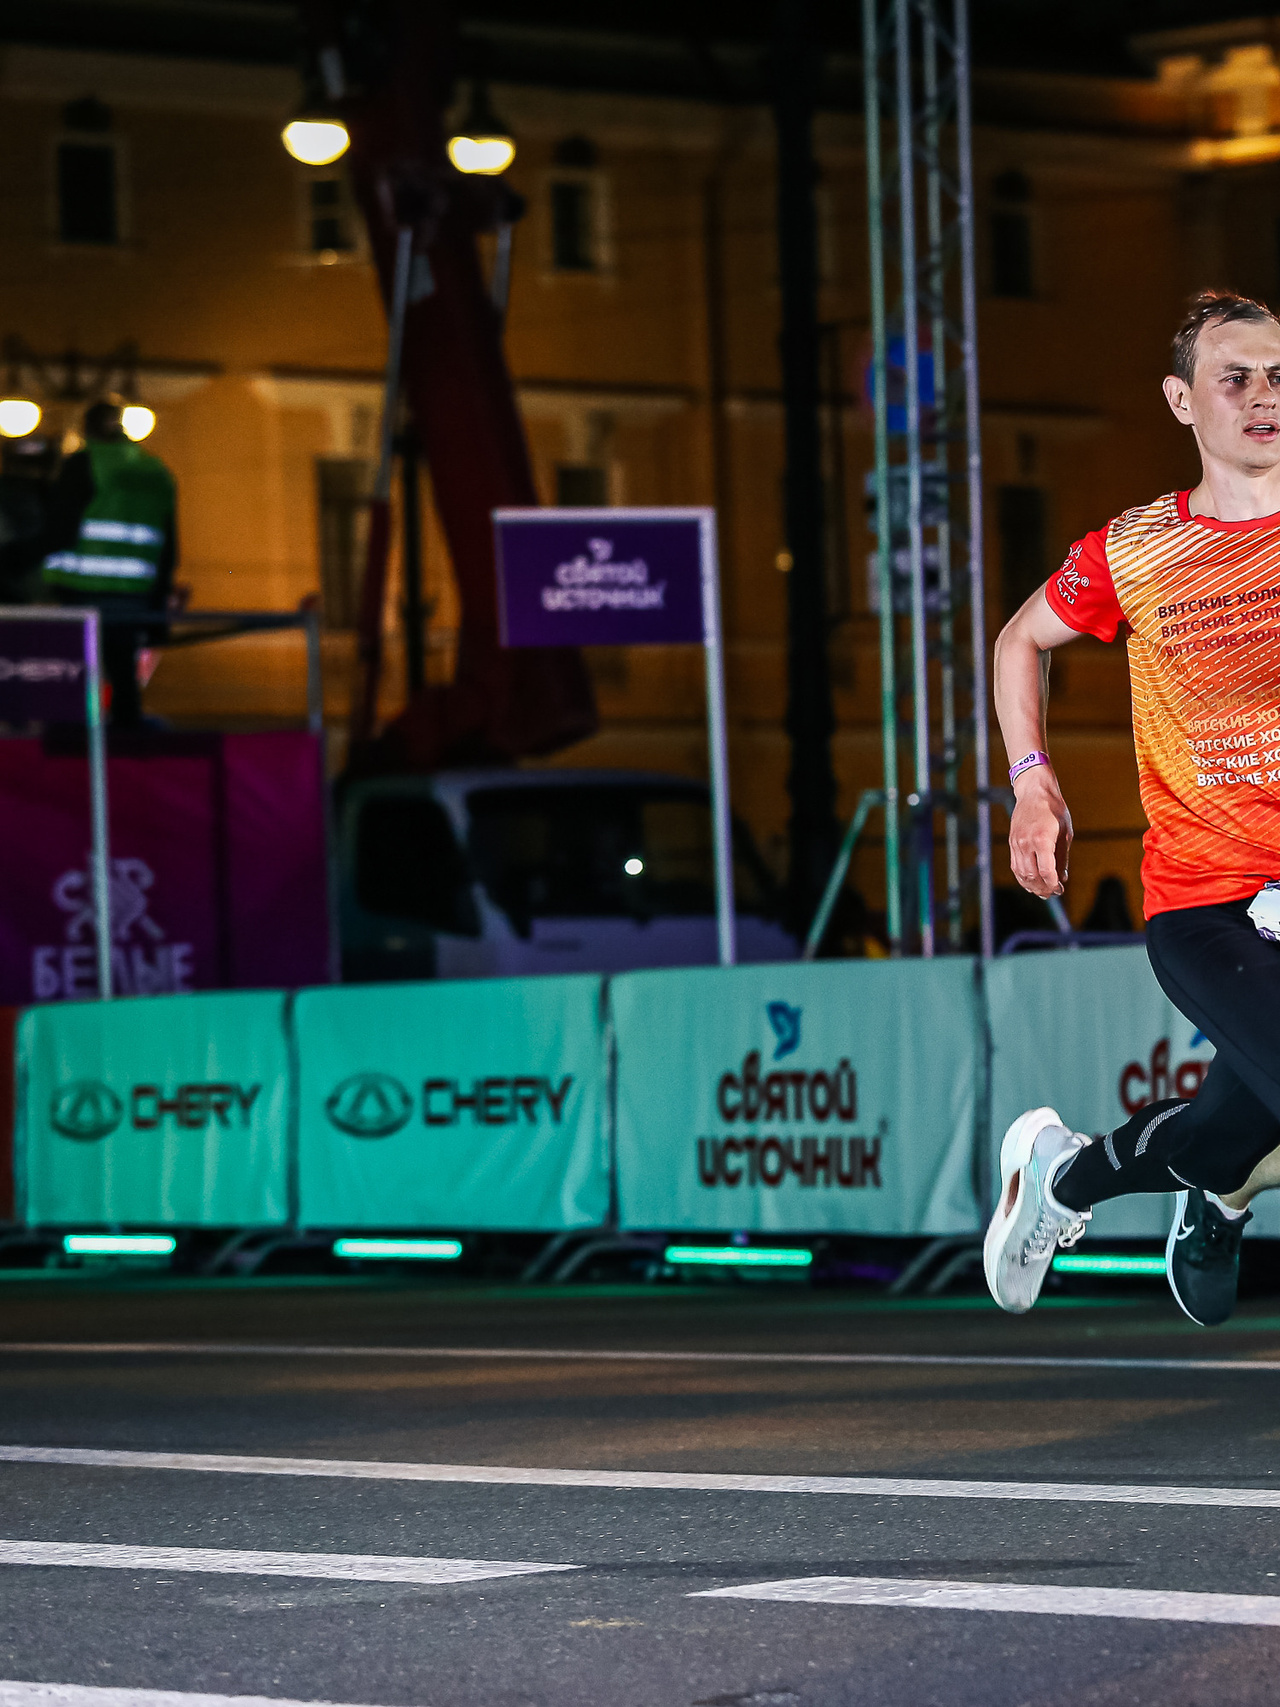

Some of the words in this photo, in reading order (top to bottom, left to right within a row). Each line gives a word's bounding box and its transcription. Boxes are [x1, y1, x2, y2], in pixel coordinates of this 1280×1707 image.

[1158, 594, 1233, 619] ВЯТСКИЕ
[1161, 614, 1235, 638] ВЯТСКИЕ
[1165, 633, 1238, 657] ВЯТСКИЕ
[1187, 711, 1252, 733] ВЯТСКИЕ
[718, 1050, 857, 1124] святой
[1119, 1037, 1213, 1117] свя
[132, 1083, 262, 1130] CHERY
[424, 1076, 574, 1126] CHERY
[697, 1136, 882, 1189] источник
